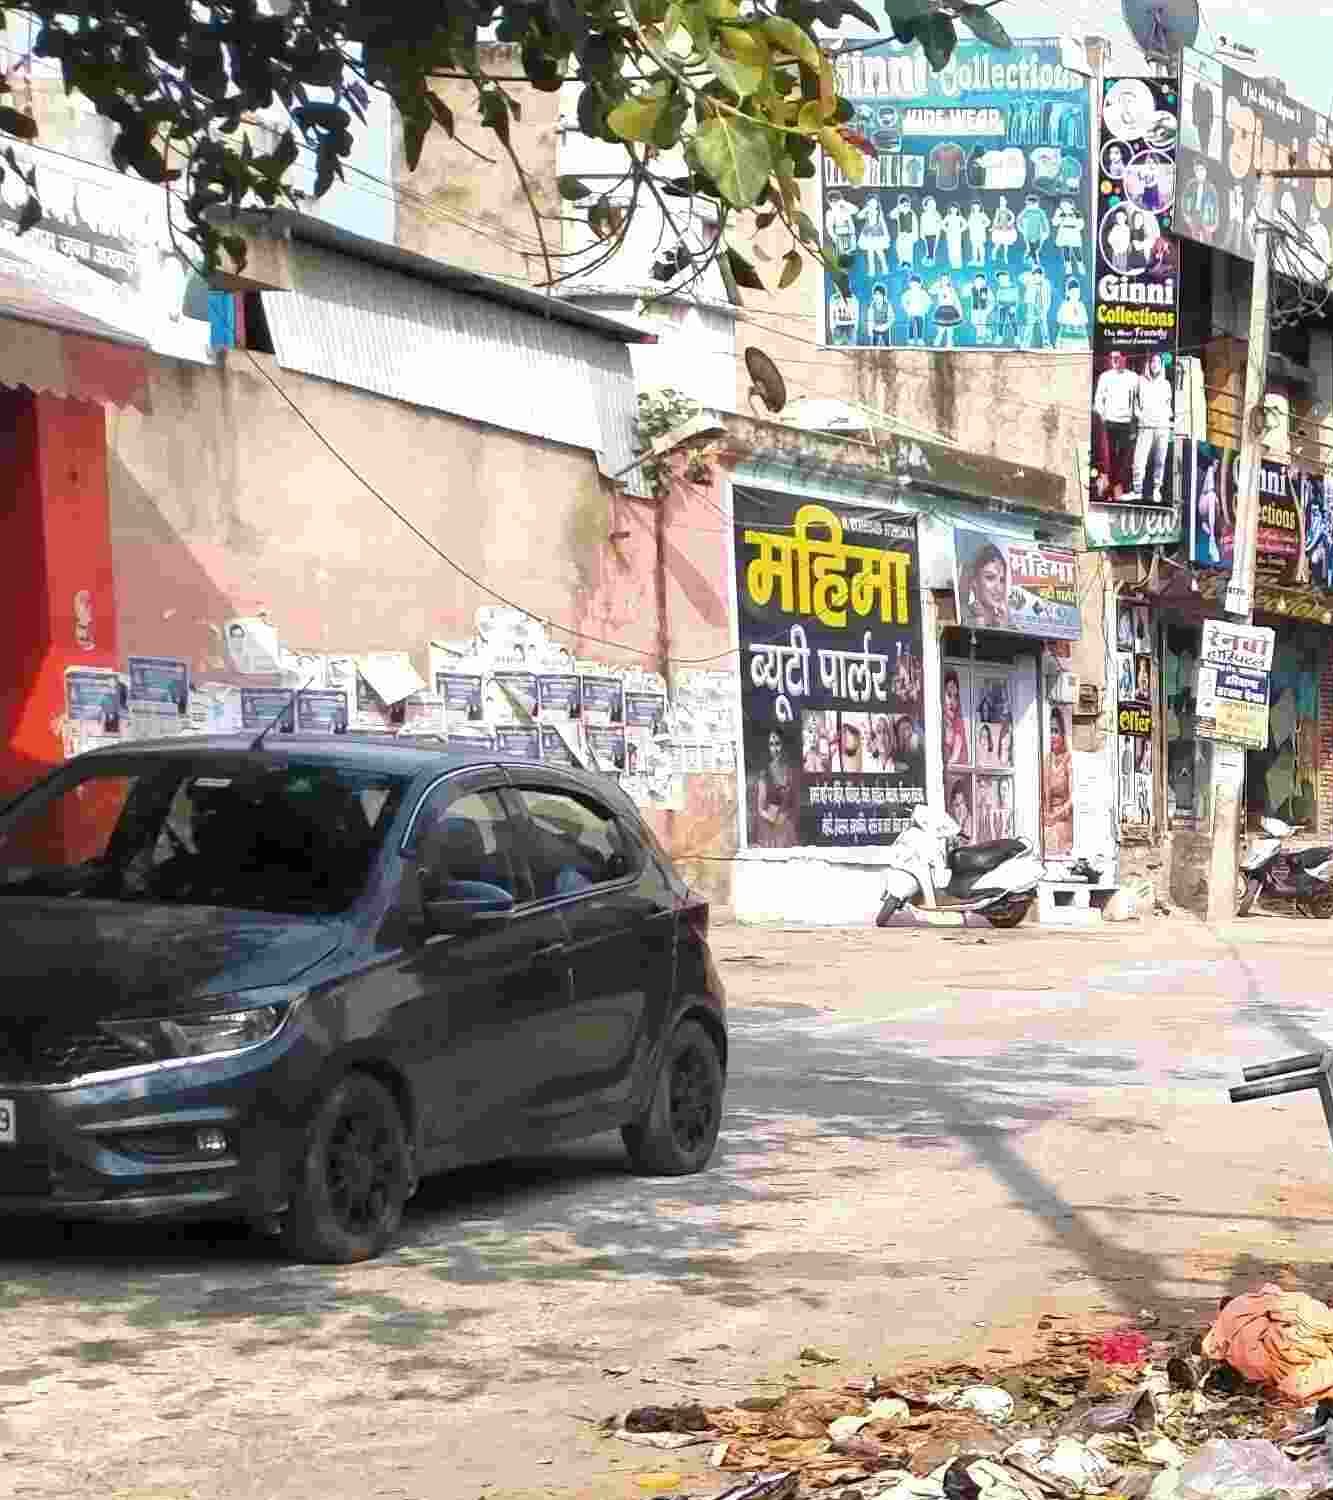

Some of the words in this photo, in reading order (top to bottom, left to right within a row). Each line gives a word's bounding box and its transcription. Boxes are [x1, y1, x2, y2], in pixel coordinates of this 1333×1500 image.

[1097, 304, 1176, 327] Collections
[1098, 274, 1174, 304] Ginni
[744, 503, 912, 629] महिमा
[749, 623, 811, 722] ब्यूटी
[817, 630, 889, 703] पार्लर
